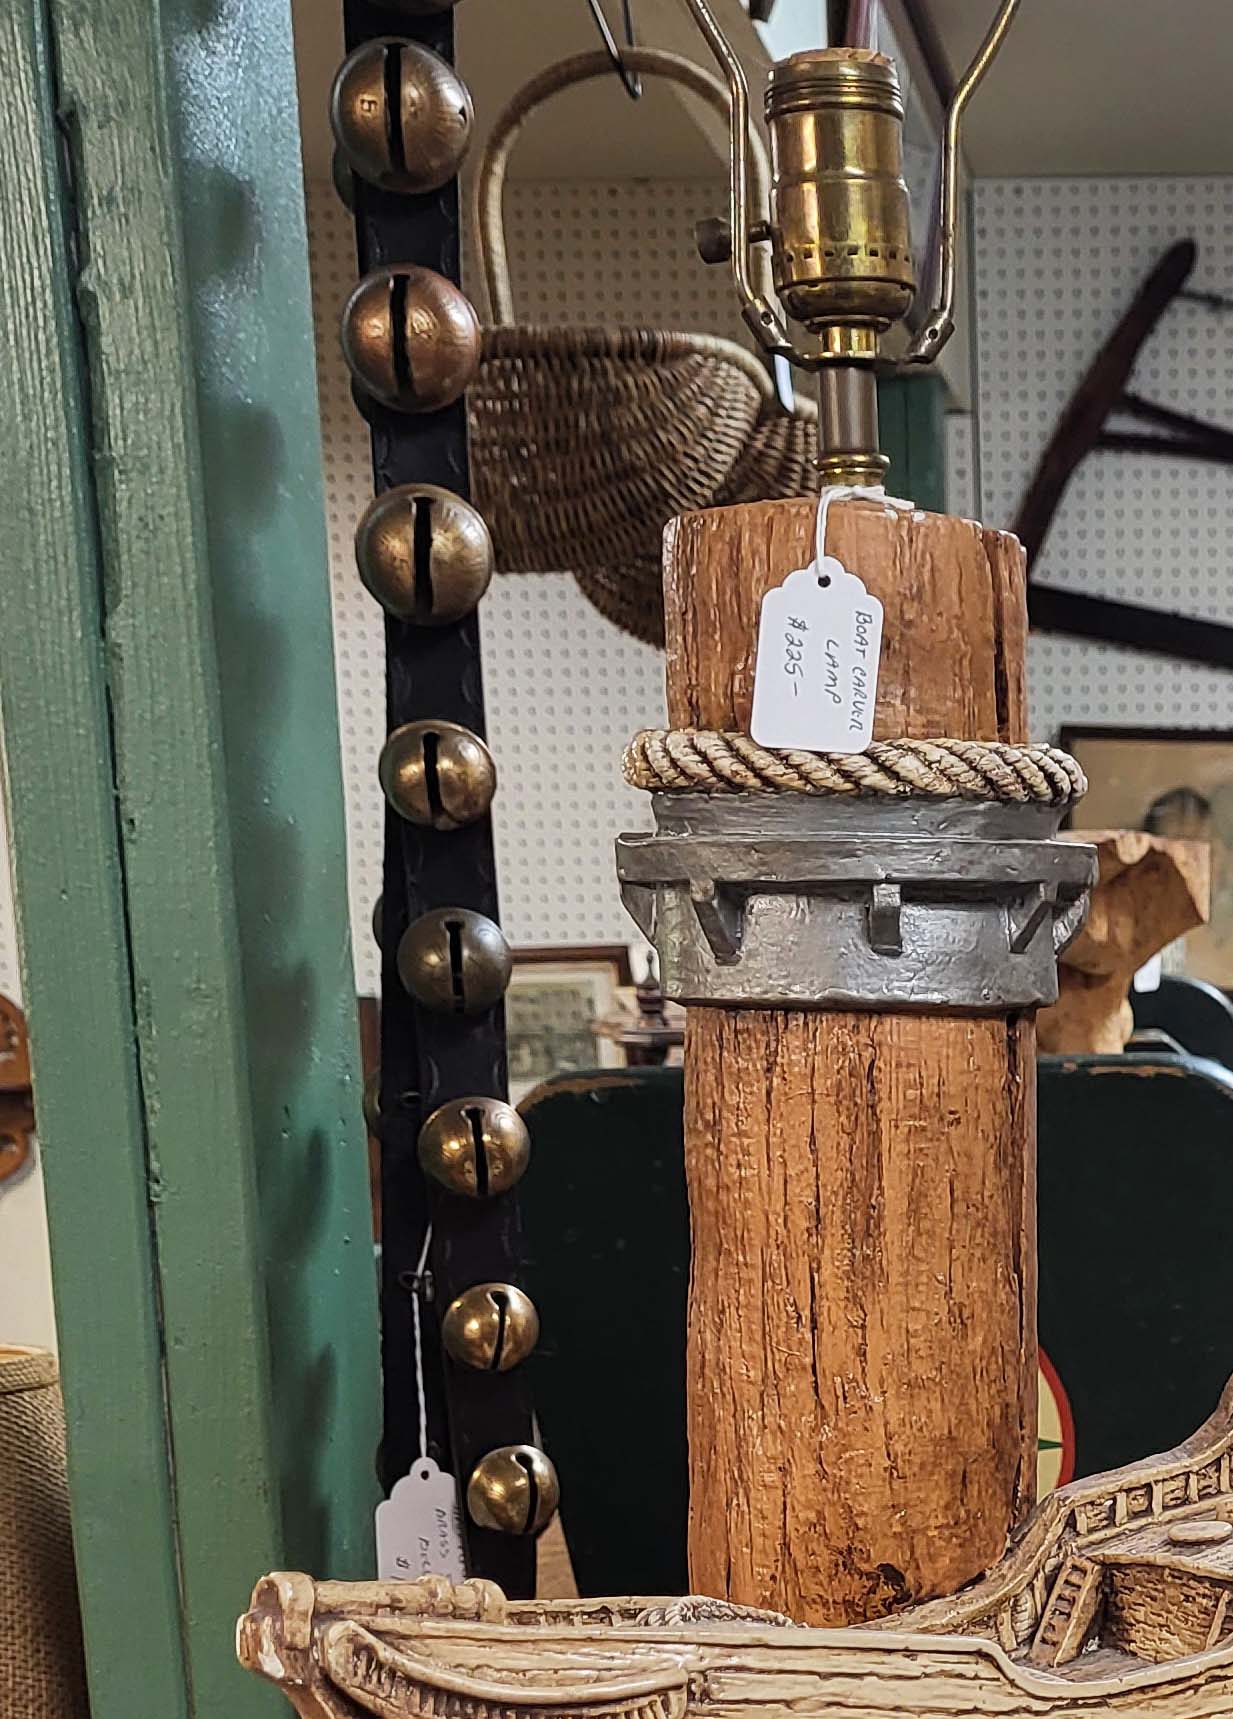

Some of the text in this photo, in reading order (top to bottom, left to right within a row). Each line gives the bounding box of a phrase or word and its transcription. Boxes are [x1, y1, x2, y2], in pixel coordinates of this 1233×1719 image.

[824, 639, 842, 705] LAMP
[849, 610, 873, 731] BOAT CARVER
